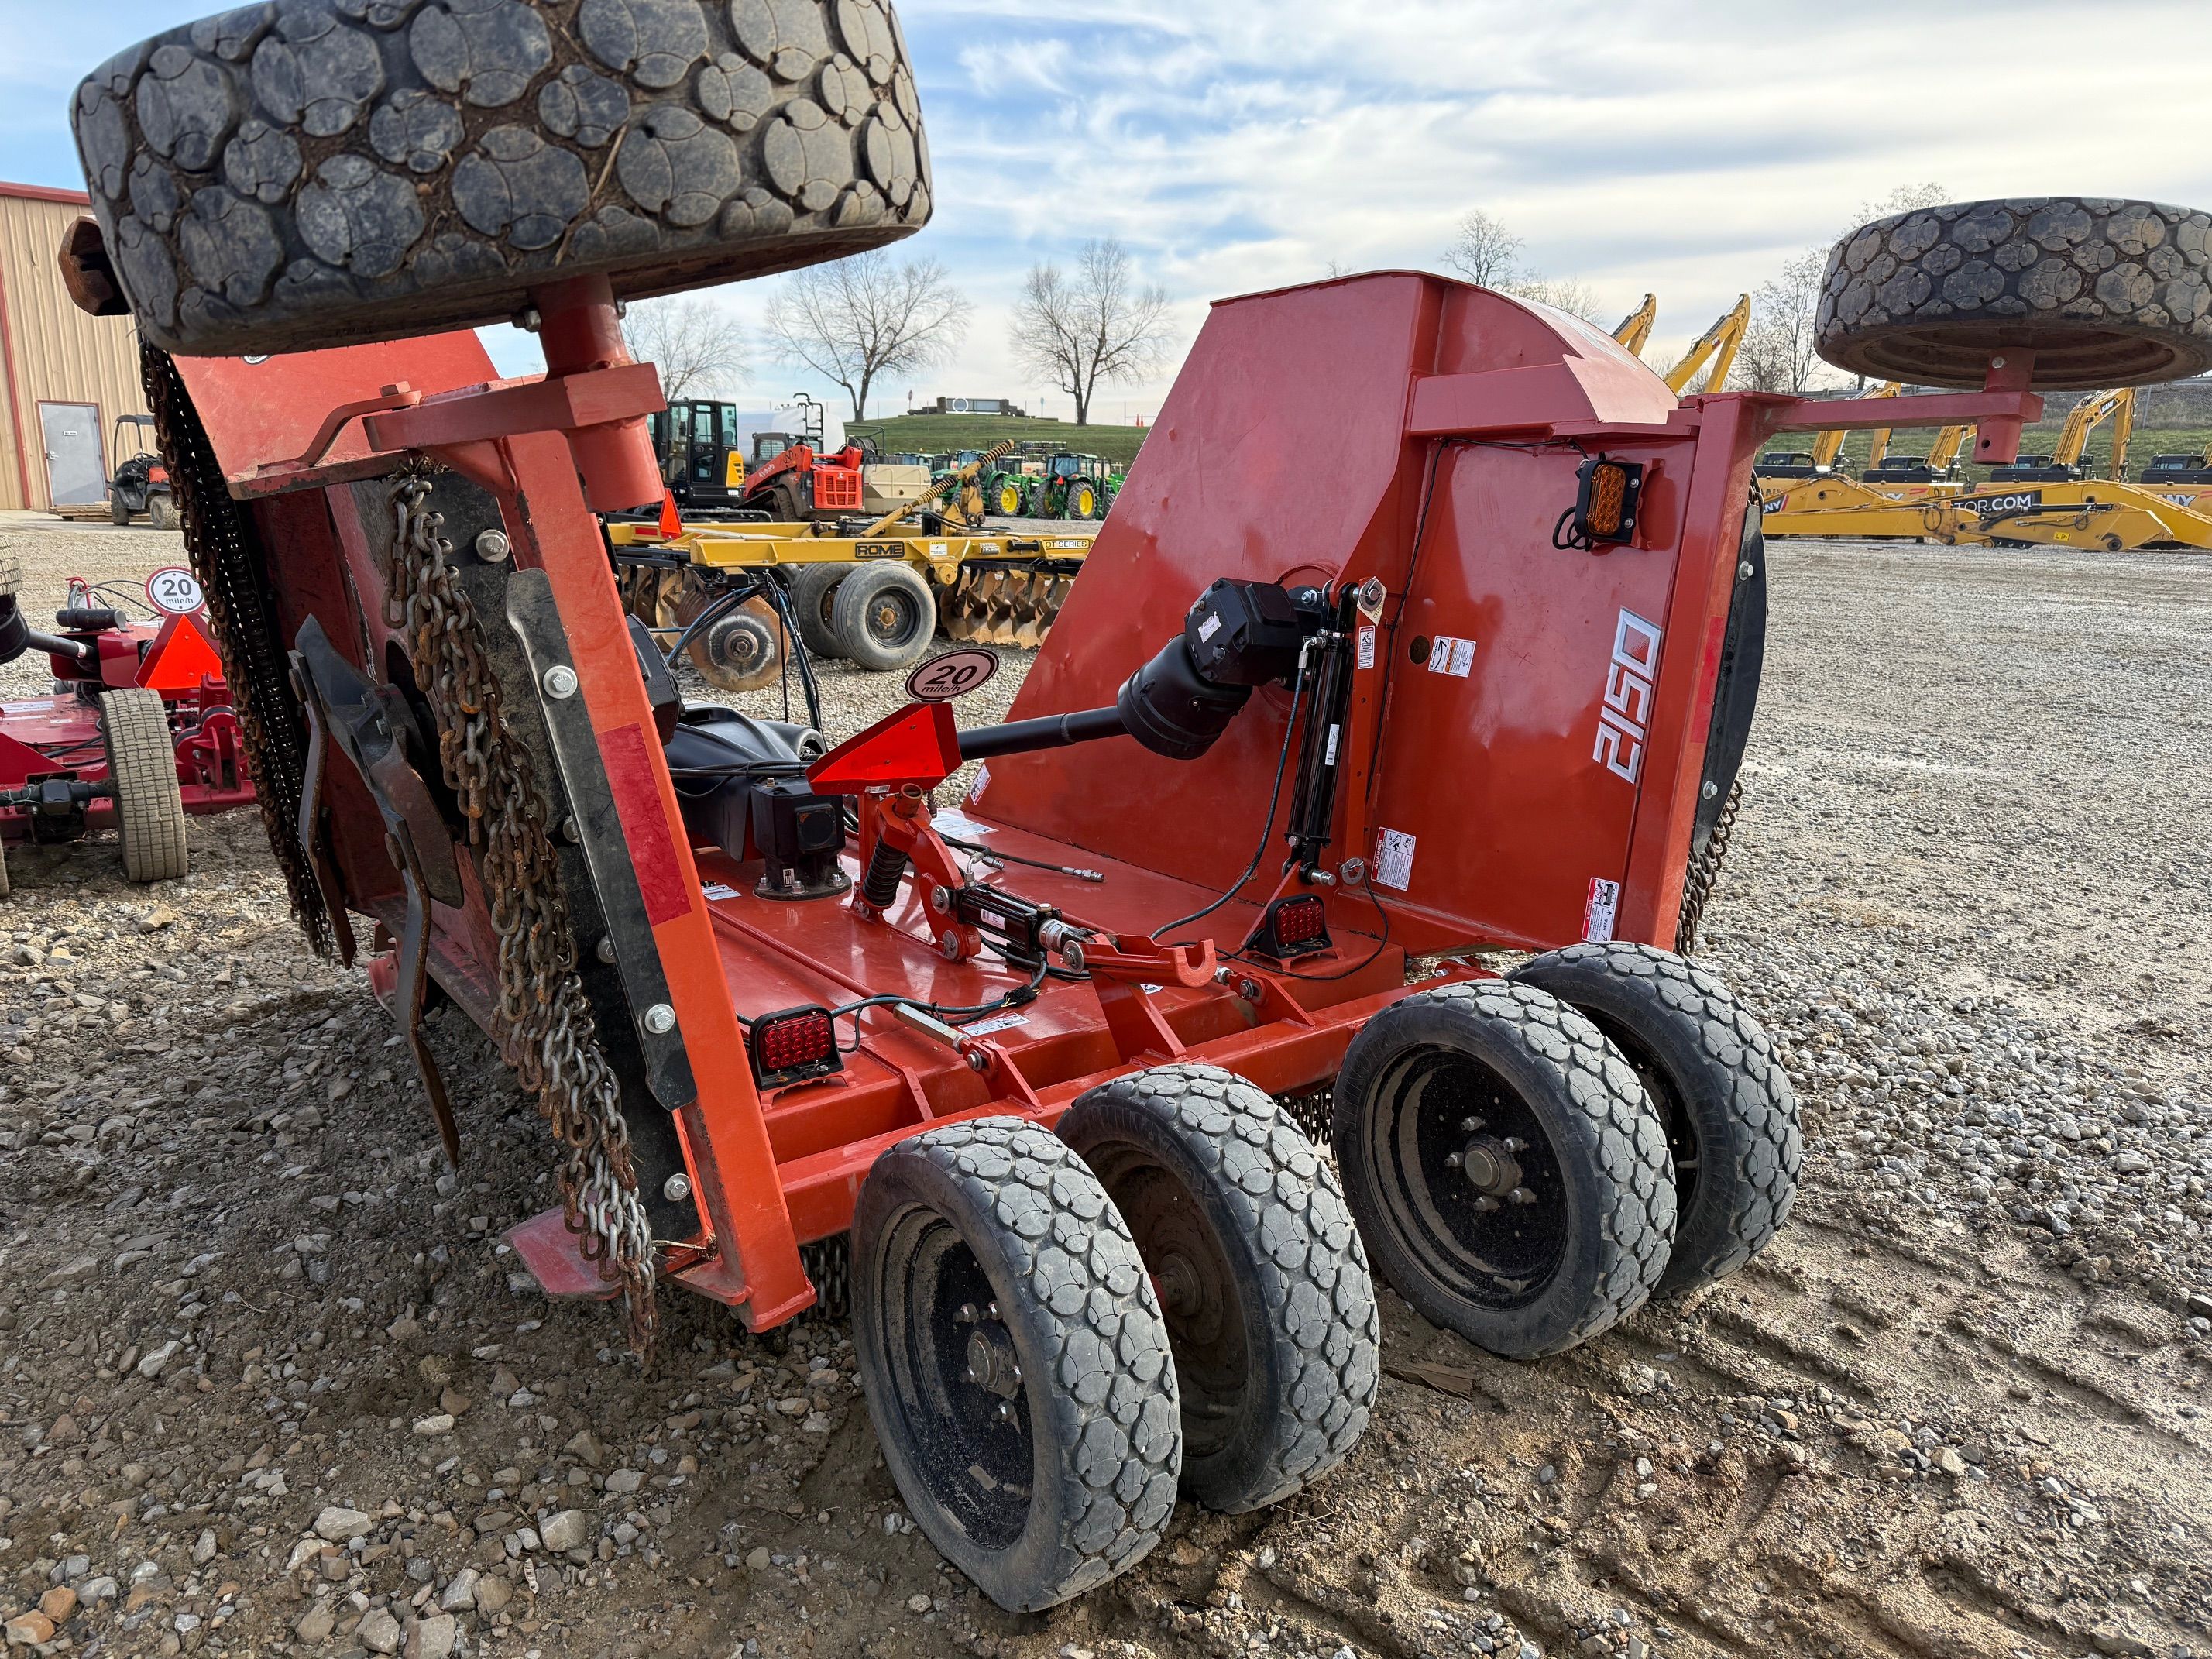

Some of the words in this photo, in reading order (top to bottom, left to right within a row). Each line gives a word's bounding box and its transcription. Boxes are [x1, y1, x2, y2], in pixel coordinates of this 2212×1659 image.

[1951, 494, 2032, 513] TOR.COM
[857, 544, 902, 555] ROME
[162, 579, 192, 596] 20
[925, 665, 978, 685] 20
[1375, 839, 1383, 864] DANGER
